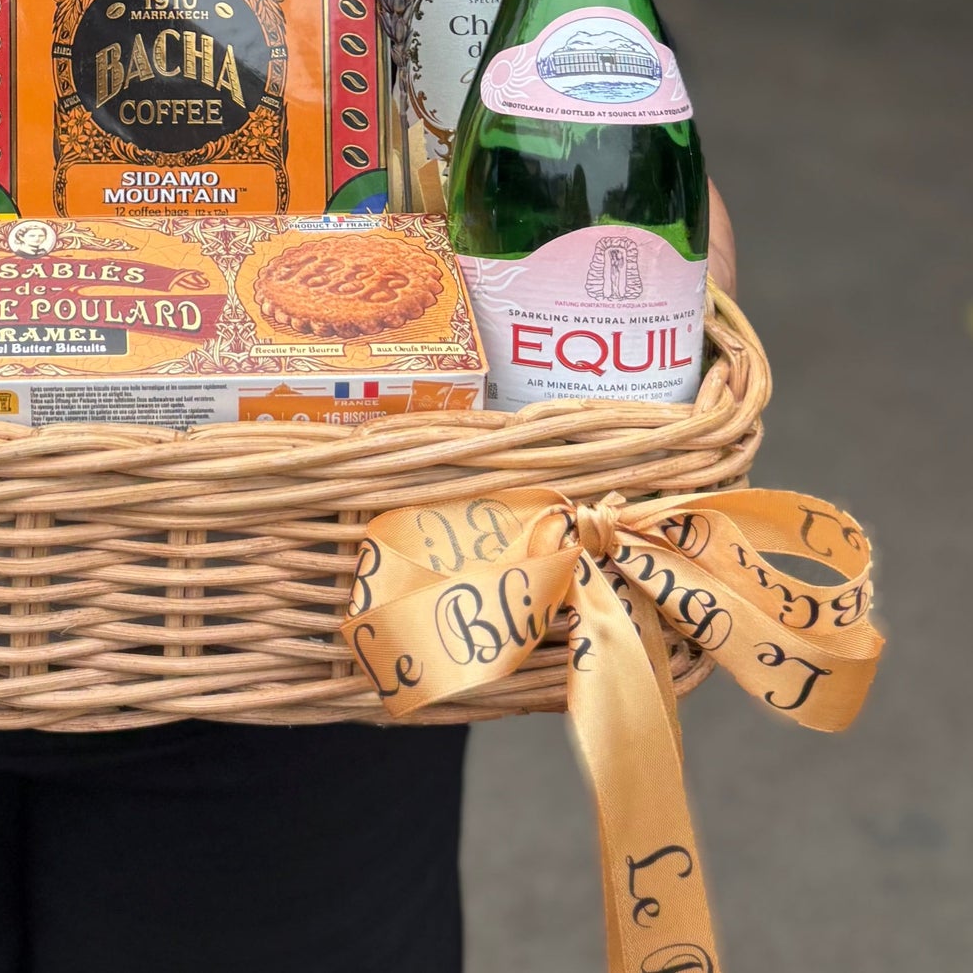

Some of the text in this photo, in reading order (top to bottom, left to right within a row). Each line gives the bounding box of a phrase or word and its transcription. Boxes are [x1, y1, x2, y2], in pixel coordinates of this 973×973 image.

[130, 11, 209, 20] MARRAKECH
[468, 41, 482, 58] d
[95, 29, 246, 109] BACHA
[119, 98, 224, 125] COFFEE
[561, 109, 595, 117] BOTTLED
[121, 171, 219, 186] SIDAMO
[103, 188, 238, 204] MOUNTAIN
[115, 207, 125, 216] 12
[129, 207, 161, 216] coffee
[164, 207, 189, 216] bags
[0, 261, 145, 283] SABLÉS
[30, 298, 202, 332] POULARD
[508, 309, 695, 324] SPARKLING NATURAL MINERAL WATER
[12, 343, 53, 354] Butter
[55, 342, 107, 353] Biscuits
[290, 346, 306, 354] Pur
[311, 346, 339, 354] Beurre
[421, 345, 443, 353] Plein
[445, 345, 460, 353] Air
[527, 377, 684, 392] AIR MINERAL ALAMI DIKARBONASI
[322, 412, 341, 426] 16
[353, 623, 423, 698] Le
[435, 568, 553, 666] Bli
[754, 641, 833, 711] Le
[626, 844, 694, 928] Le
